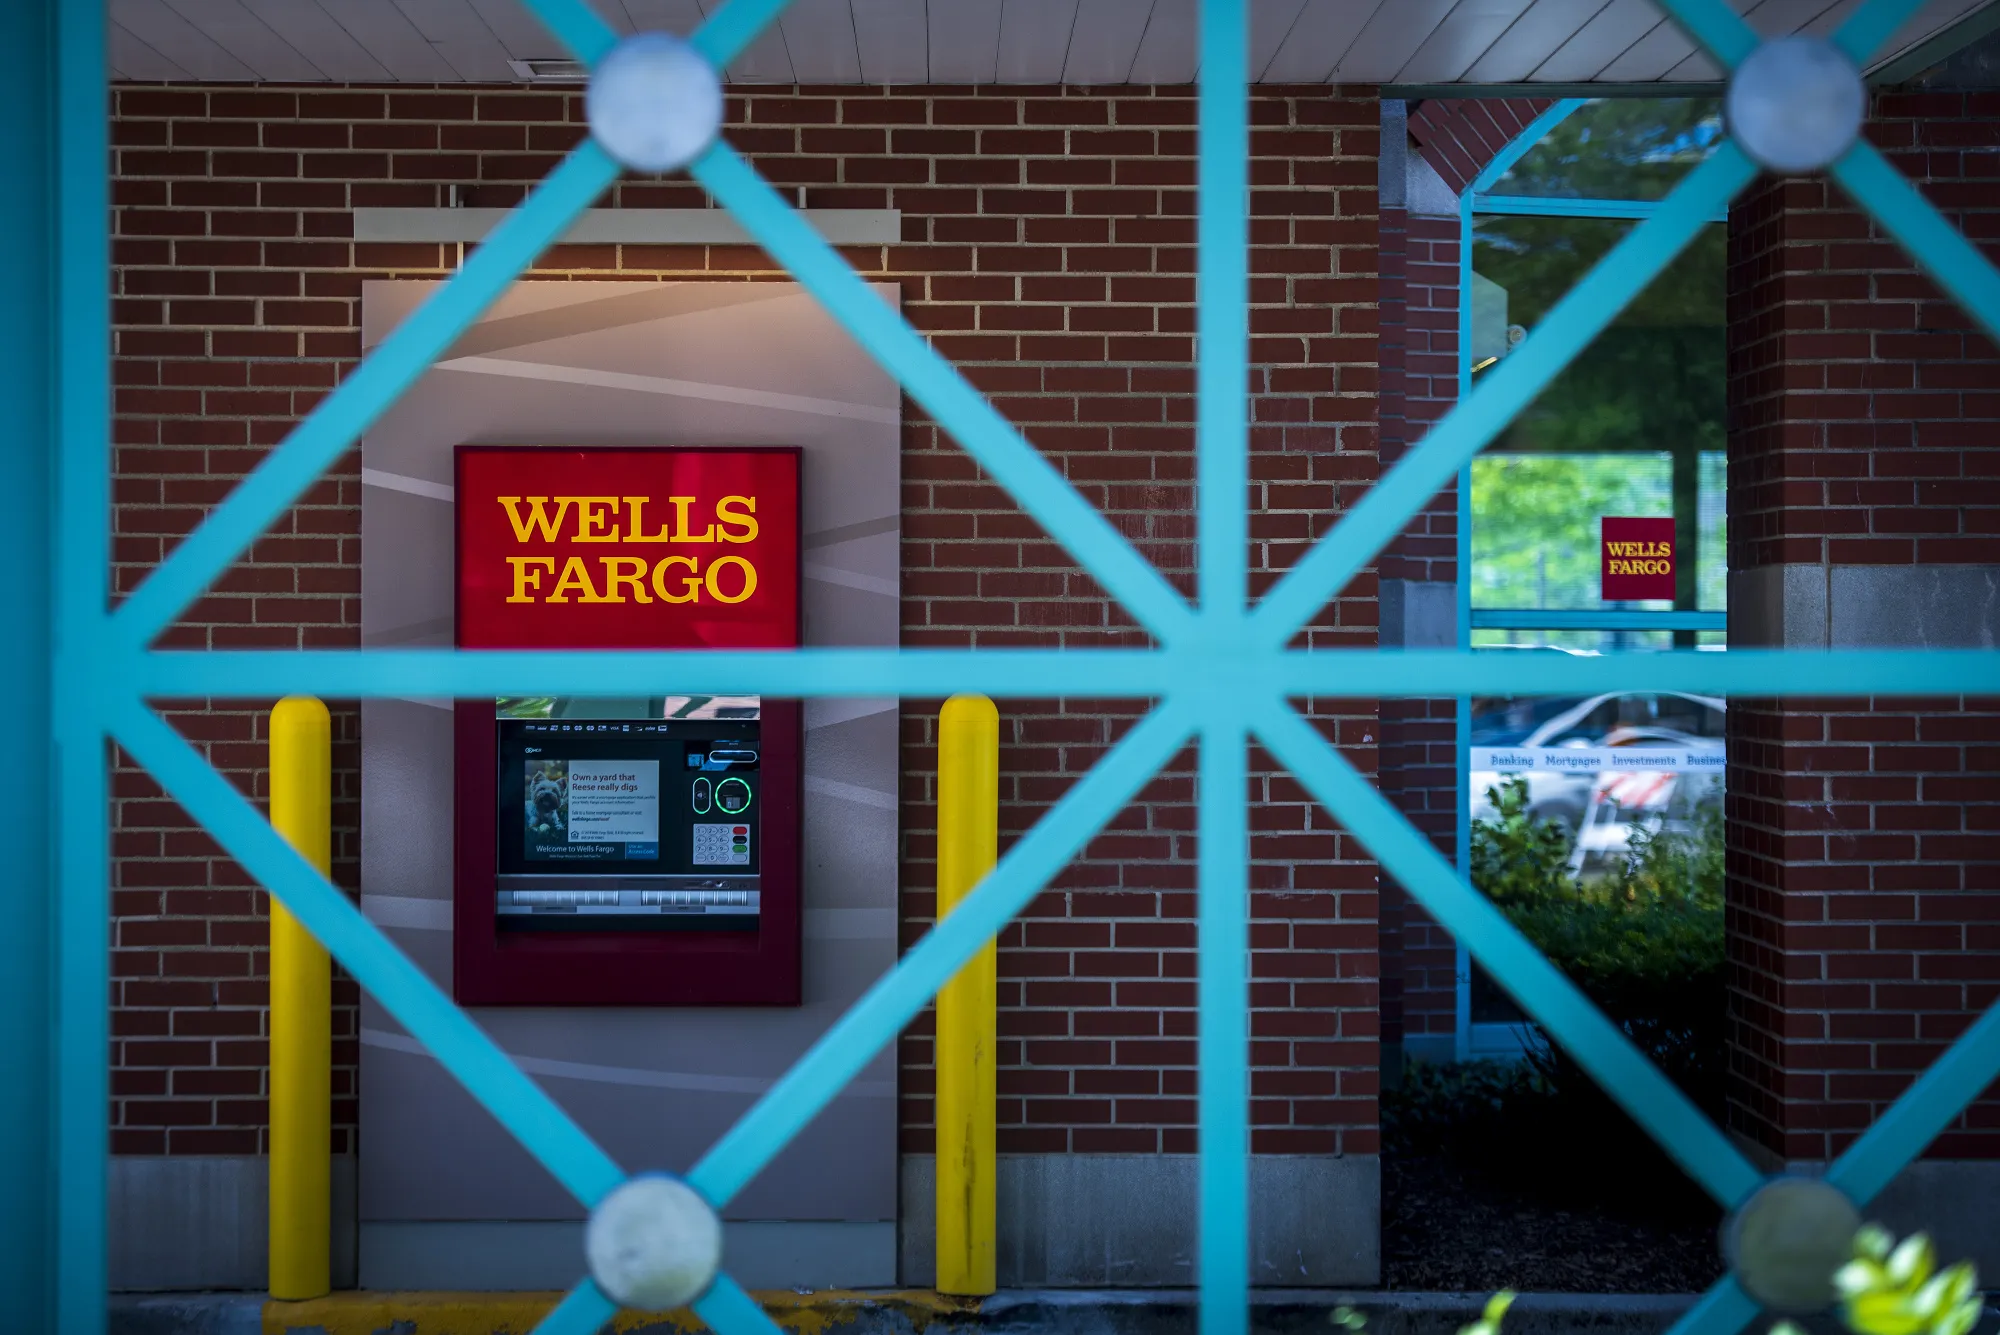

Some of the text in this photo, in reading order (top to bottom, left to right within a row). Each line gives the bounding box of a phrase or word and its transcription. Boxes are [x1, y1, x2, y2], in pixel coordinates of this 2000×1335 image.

[497, 495, 759, 543] WELLS
[1606, 541, 1671, 557] WELLS
[1608, 559, 1671, 575] FARGO
[506, 555, 758, 604] FARGO
[1490, 755, 1534, 767] Banking
[1545, 755, 1601, 767] Mortgages
[1612, 755, 1677, 766] Investments
[572, 774, 591, 782] Own
[599, 774, 617, 784] yard
[618, 773, 636, 782] that
[572, 783, 638, 792] Reese really digs
[536, 845, 567, 853] Welcome
[576, 845, 594, 853] Wells
[595, 845, 614, 854] Fargo
